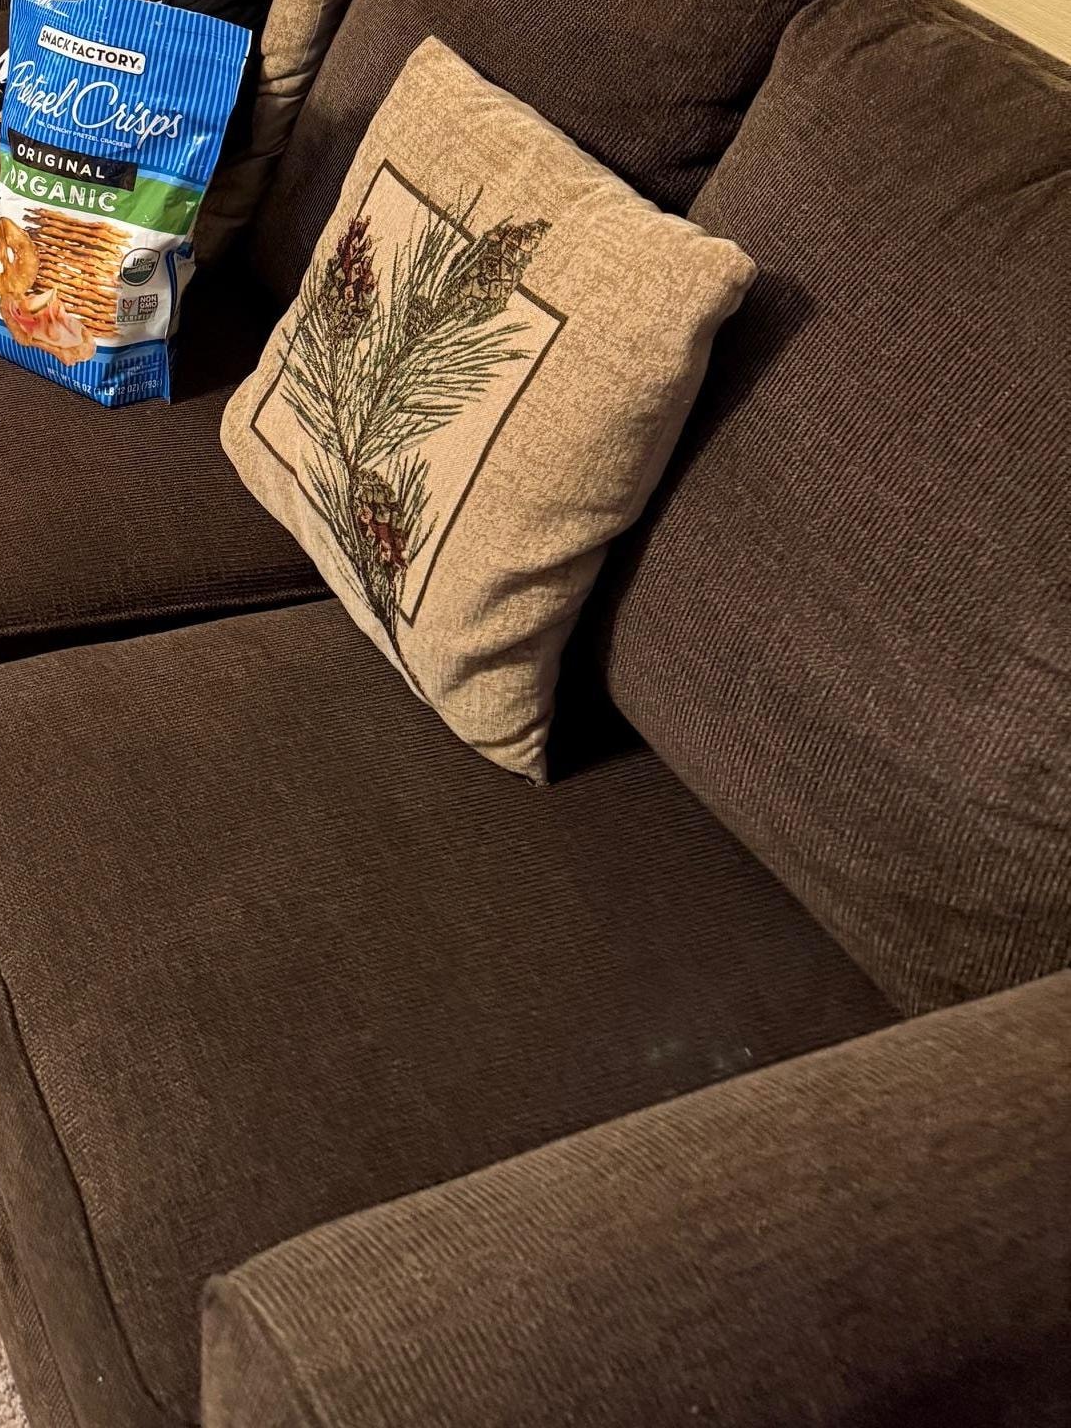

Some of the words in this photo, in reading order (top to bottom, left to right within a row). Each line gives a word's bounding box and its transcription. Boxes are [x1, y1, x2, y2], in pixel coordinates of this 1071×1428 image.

[40, 26, 71, 51] SNACK
[70, 40, 140, 71] FACTORY
[8, 59, 78, 129] Pretzel
[72, 79, 183, 152] Crisps
[72, 130, 100, 144] PRETZEL
[16, 143, 105, 179] ORIGINAL
[5, 166, 117, 213] ORGANIC
[139, 294, 157, 302] NON
[81, 381, 93, 393] OZ
[104, 386, 115, 396] LB
